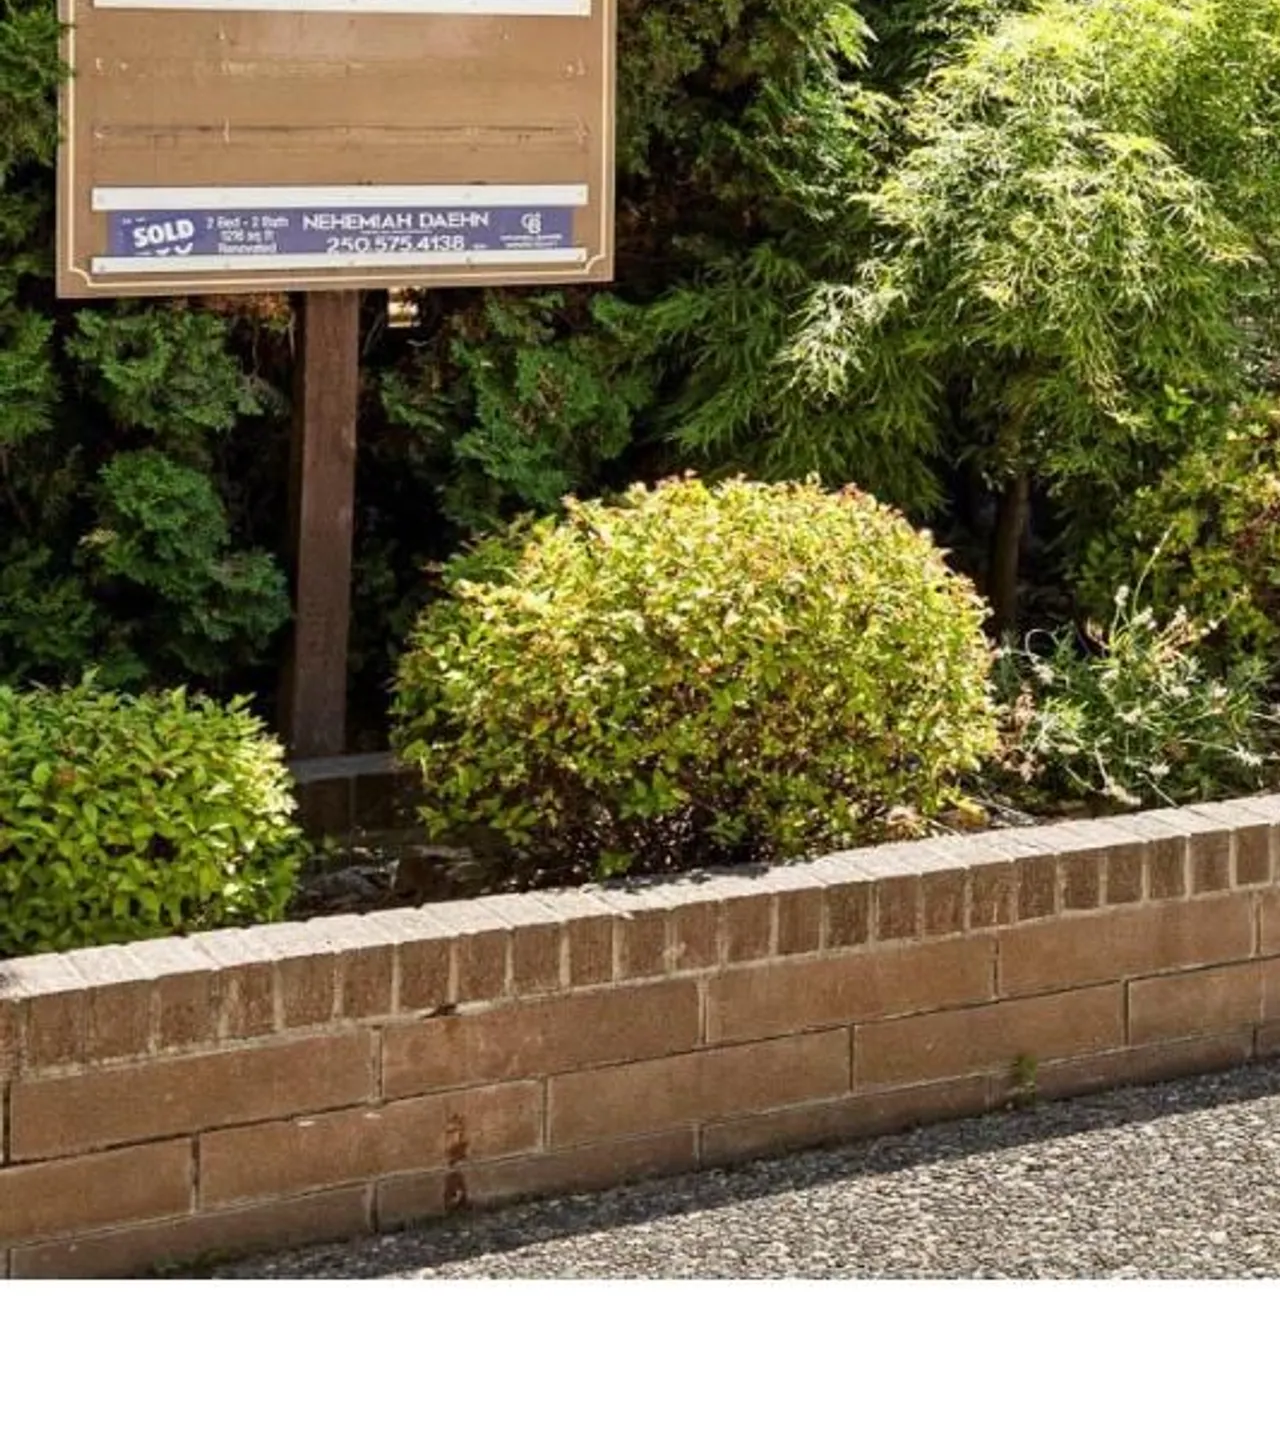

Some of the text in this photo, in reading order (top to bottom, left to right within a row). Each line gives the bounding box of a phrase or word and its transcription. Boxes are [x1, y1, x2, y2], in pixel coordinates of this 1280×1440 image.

[133, 218, 195, 248] SOLD
[302, 211, 489, 231] NEHEMIAH DAEHN
